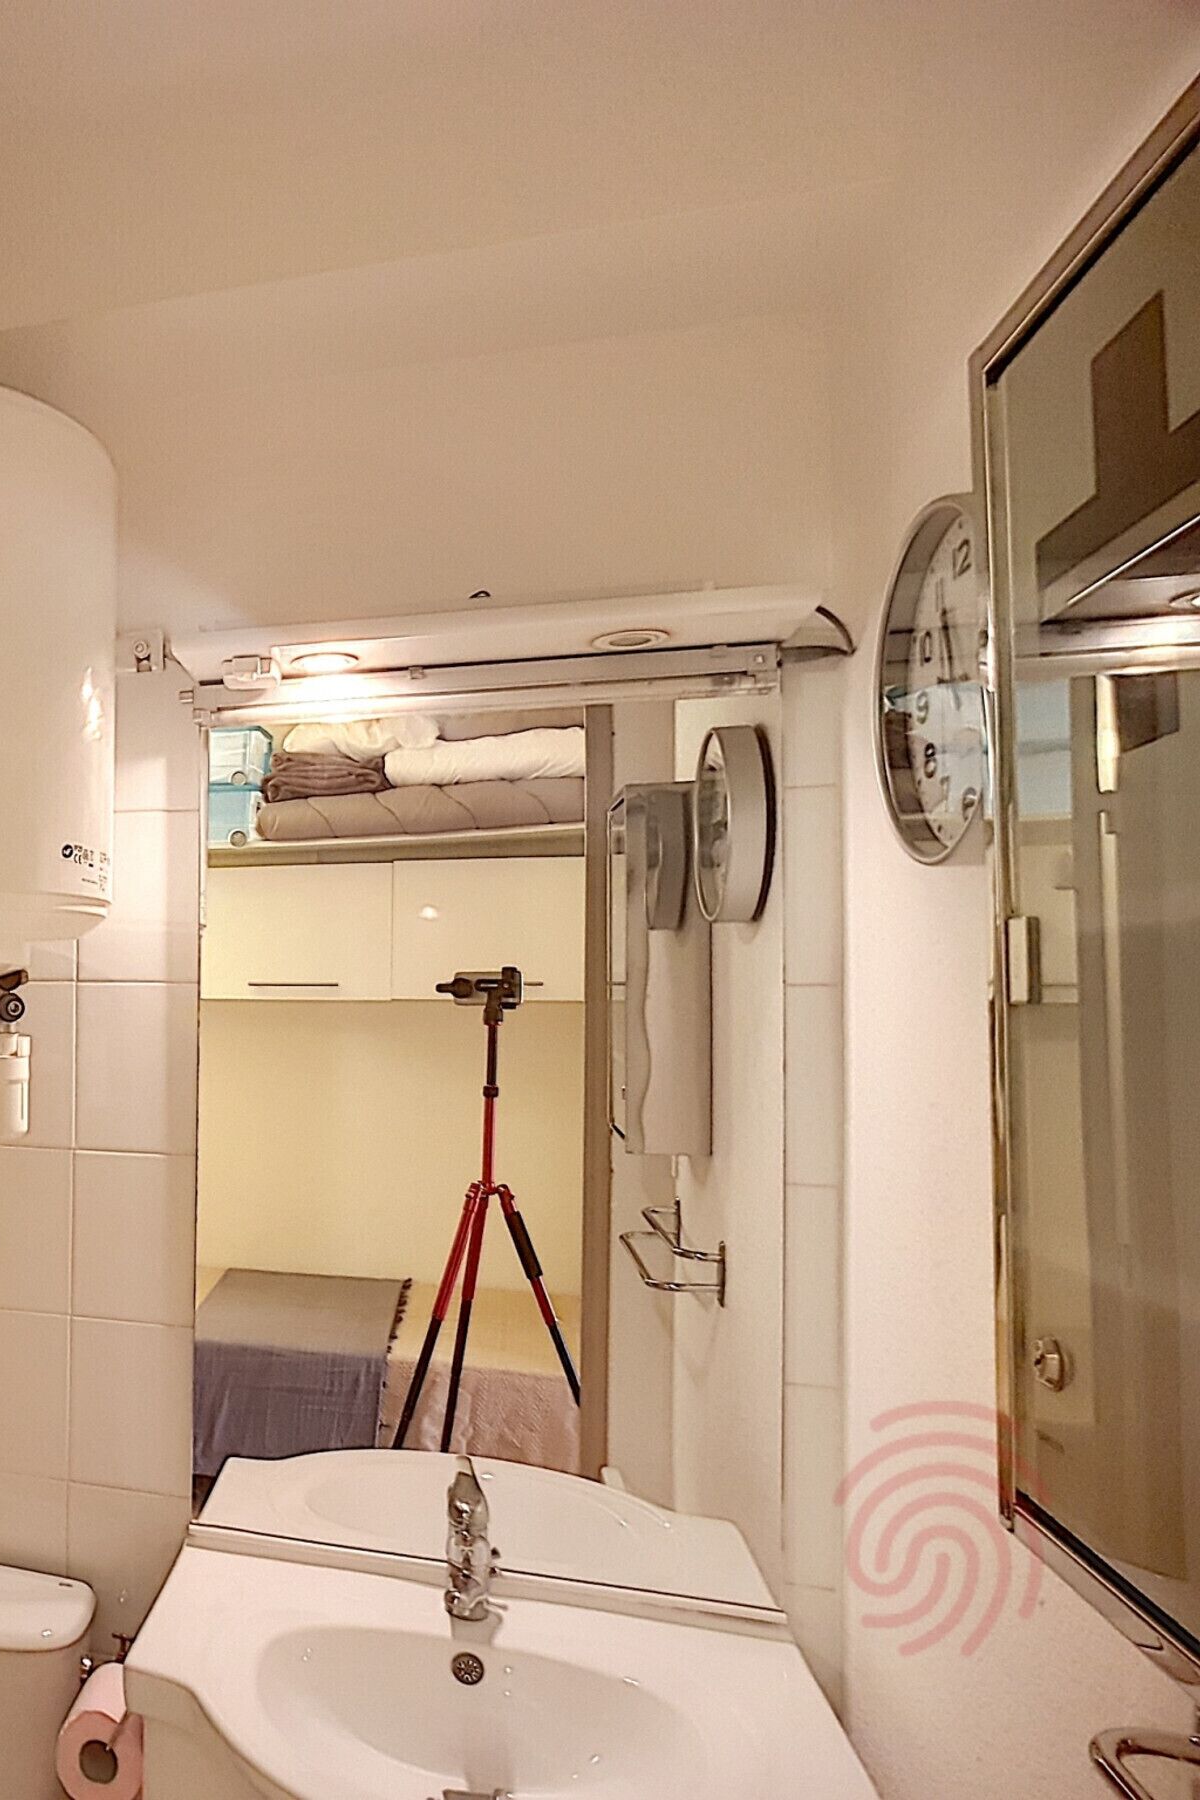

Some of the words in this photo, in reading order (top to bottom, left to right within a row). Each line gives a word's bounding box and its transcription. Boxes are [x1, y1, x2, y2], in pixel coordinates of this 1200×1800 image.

[953, 538, 972, 581] 12
[916, 690, 929, 725] 9
[924, 742, 937, 779] 8
